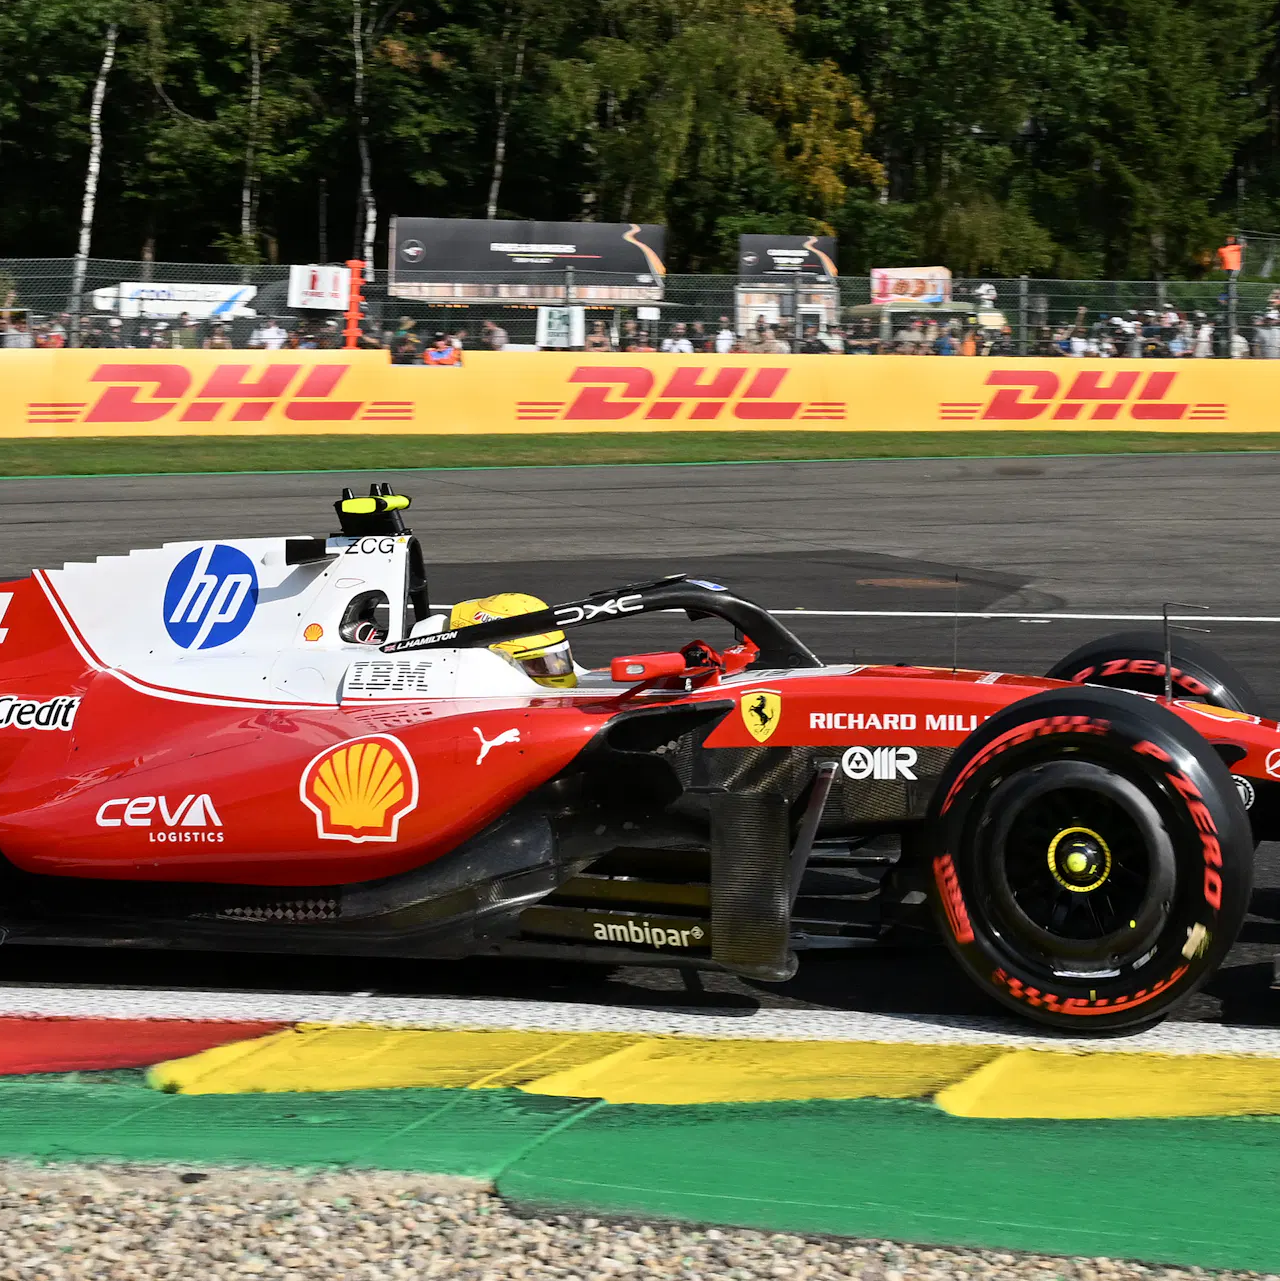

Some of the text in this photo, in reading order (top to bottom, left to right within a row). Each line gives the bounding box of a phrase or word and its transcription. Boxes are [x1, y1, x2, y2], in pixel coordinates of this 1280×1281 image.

[84, 363, 363, 423] DHL
[562, 366, 802, 420] DHL
[982, 371, 1188, 420] DHL
[170, 543, 252, 651] hp
[554, 593, 645, 626] DXC
[397, 630, 459, 651] L.HAMILTON
[348, 661, 433, 692] IBM
[809, 712, 991, 732] RICHARD MILL
[149, 832, 224, 843] LOGISTICS
[1165, 770, 1223, 910] ZERO
[593, 920, 690, 949] ambipar
